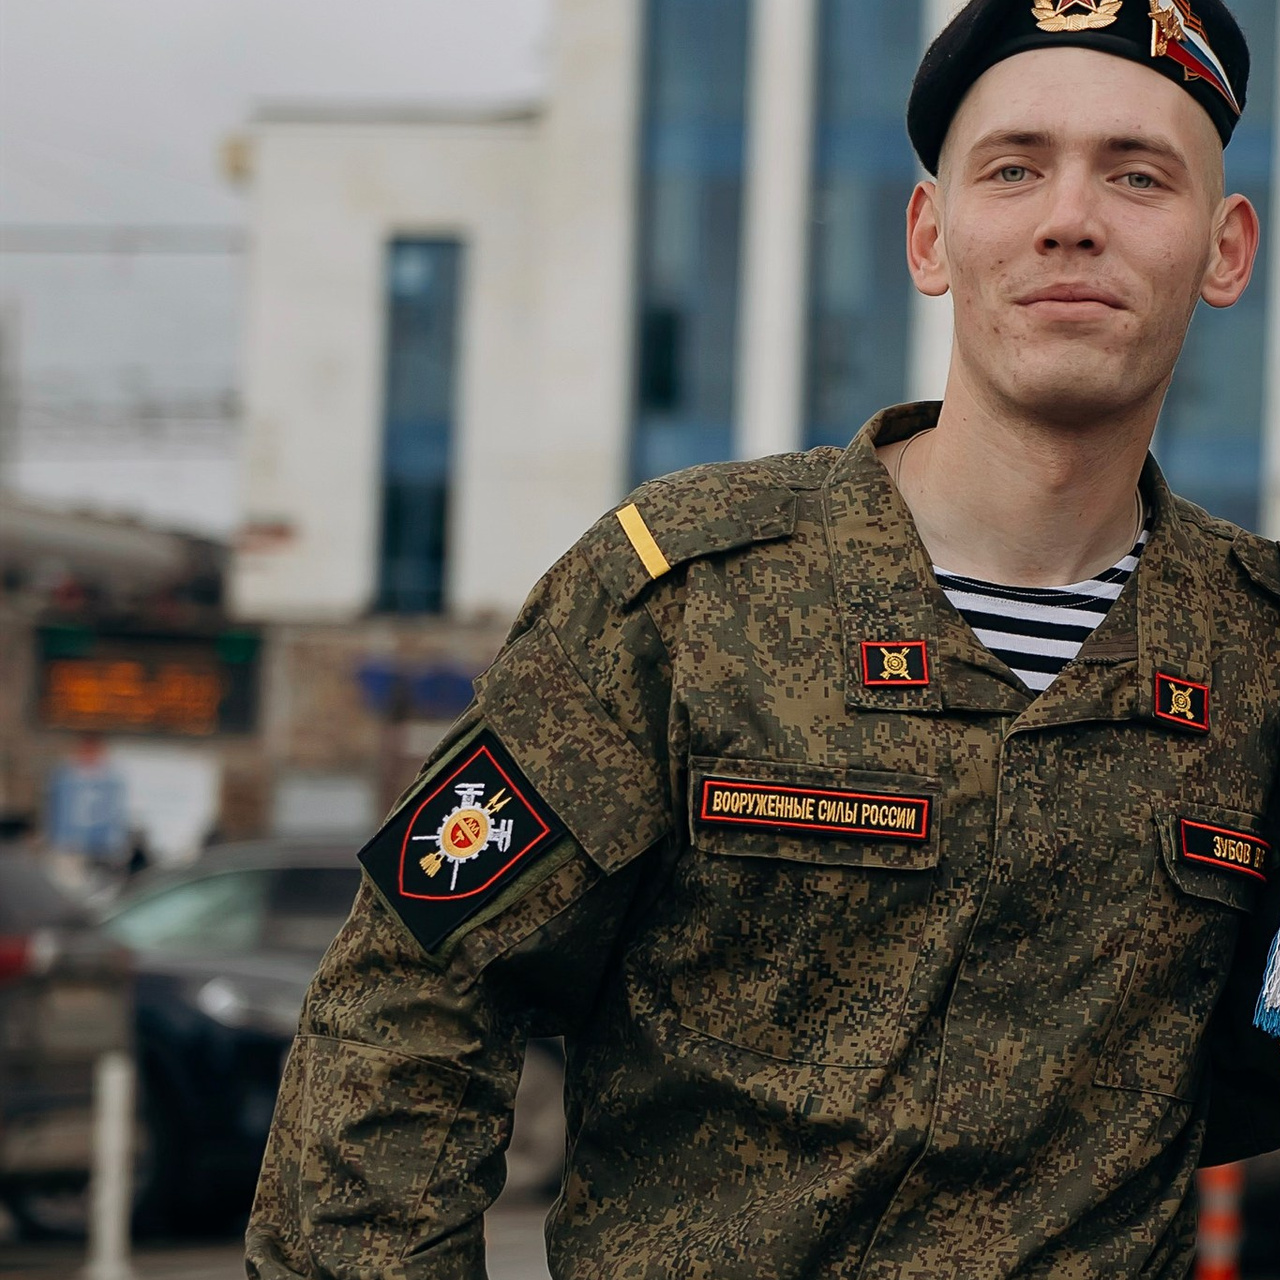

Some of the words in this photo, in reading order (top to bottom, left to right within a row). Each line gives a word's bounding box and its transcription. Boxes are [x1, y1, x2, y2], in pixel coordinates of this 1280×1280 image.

[712, 790, 815, 820] ВООРУЖЕННЫЕ
[818, 799, 858, 825] СИЛЫ
[861, 803, 916, 830] РОССИИ
[1213, 835, 1251, 864] ЗУБОВ
